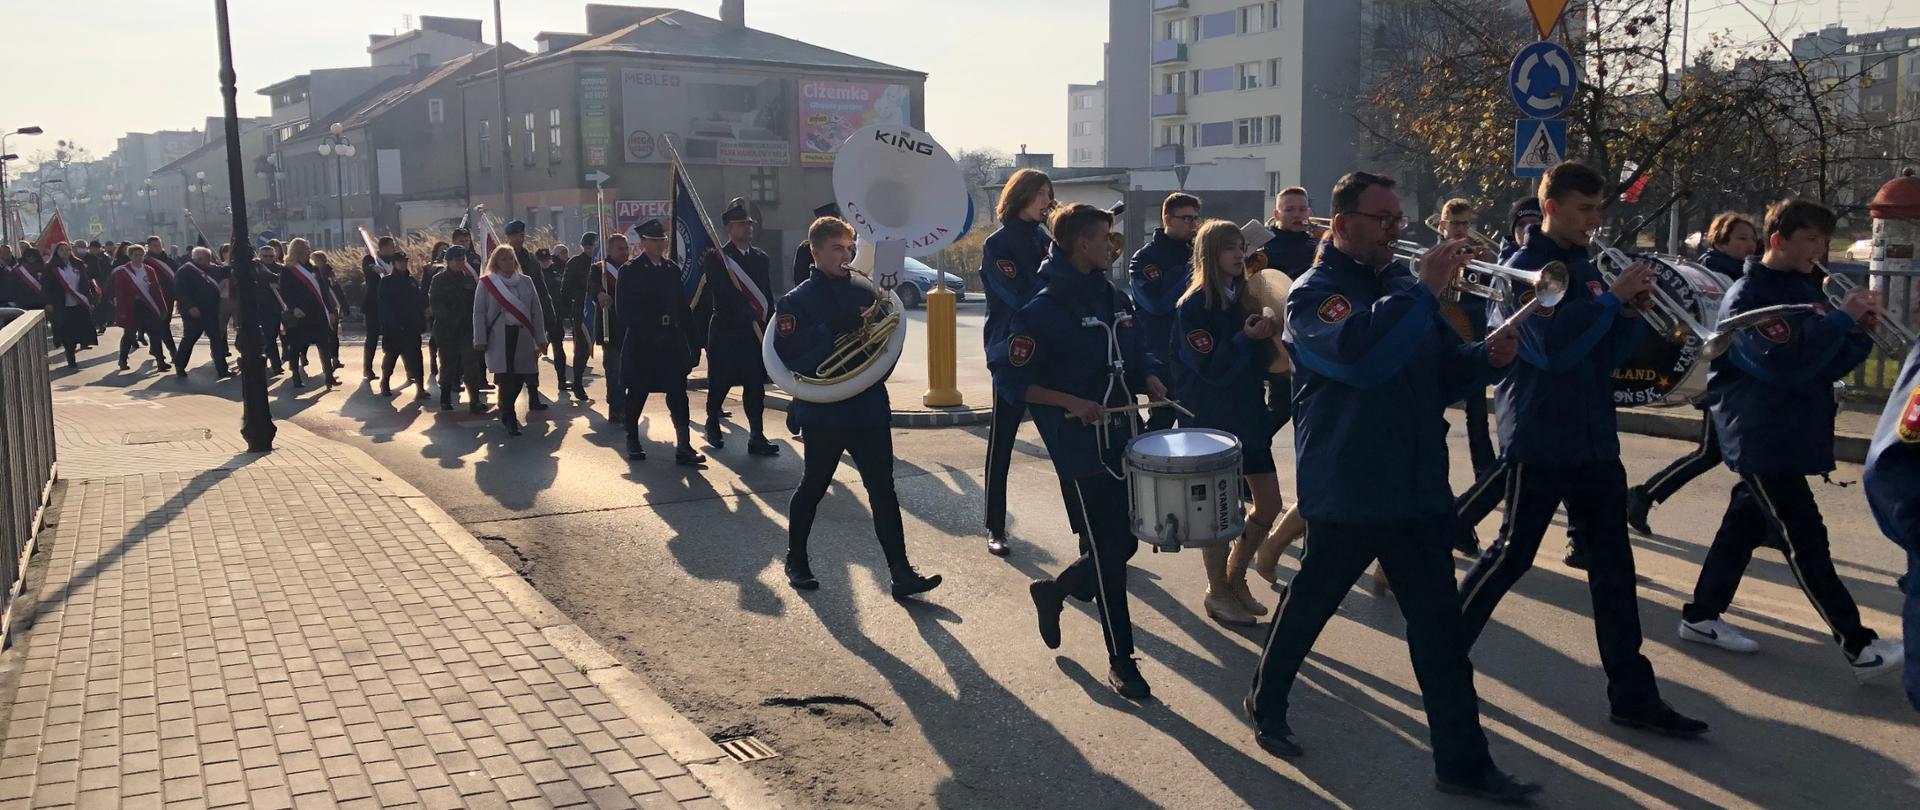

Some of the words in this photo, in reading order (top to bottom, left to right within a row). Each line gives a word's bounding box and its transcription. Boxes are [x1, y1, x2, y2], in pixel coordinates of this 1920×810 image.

[803, 82, 869, 101] Ciżemka
[875, 129, 934, 156] KING
[1610, 368, 1656, 380] LAND
[1218, 491, 1229, 532] YAMAHA
